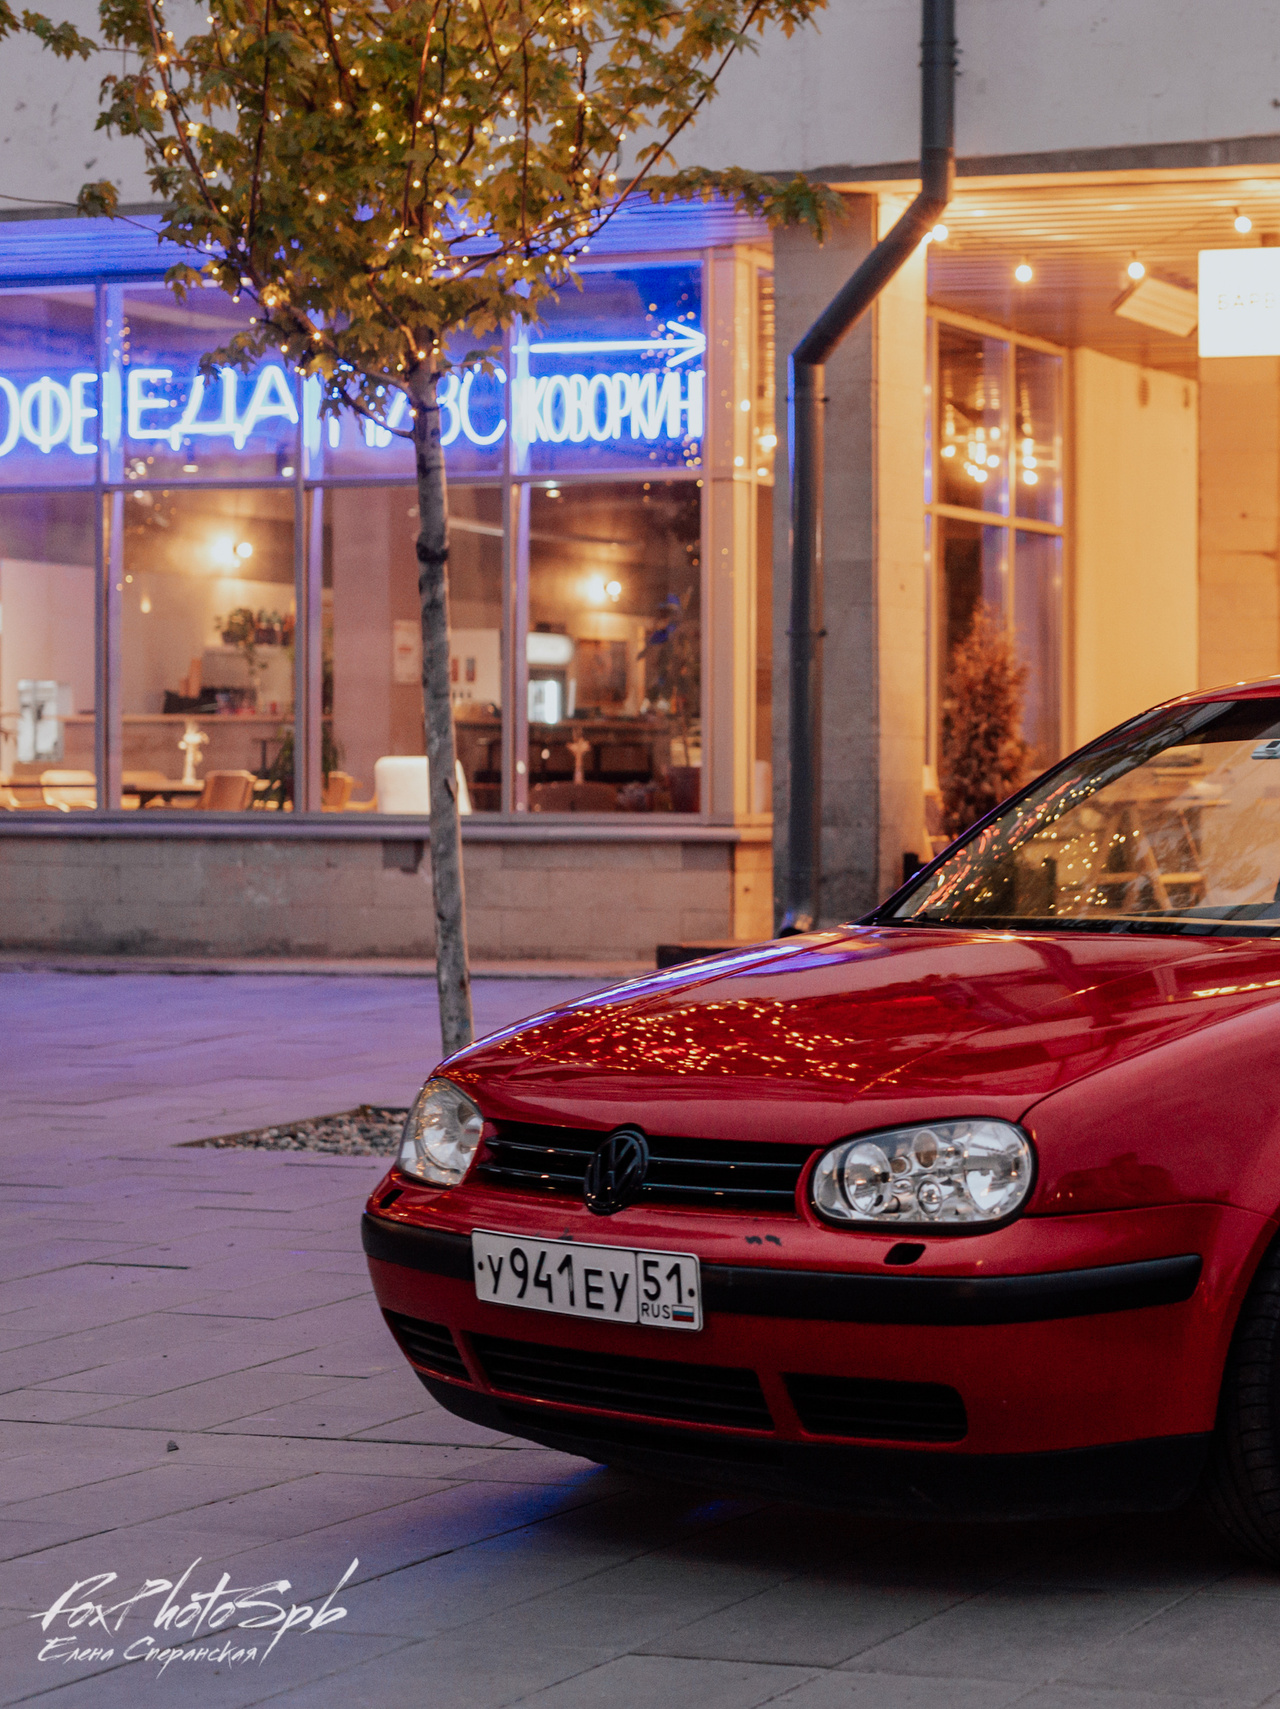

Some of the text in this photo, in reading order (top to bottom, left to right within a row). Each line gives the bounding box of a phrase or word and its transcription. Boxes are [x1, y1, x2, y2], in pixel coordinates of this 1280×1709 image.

[128, 364, 299, 451] ЕДА
[643, 1260, 683, 1304] 51
[641, 1302, 671, 1319] RUS
